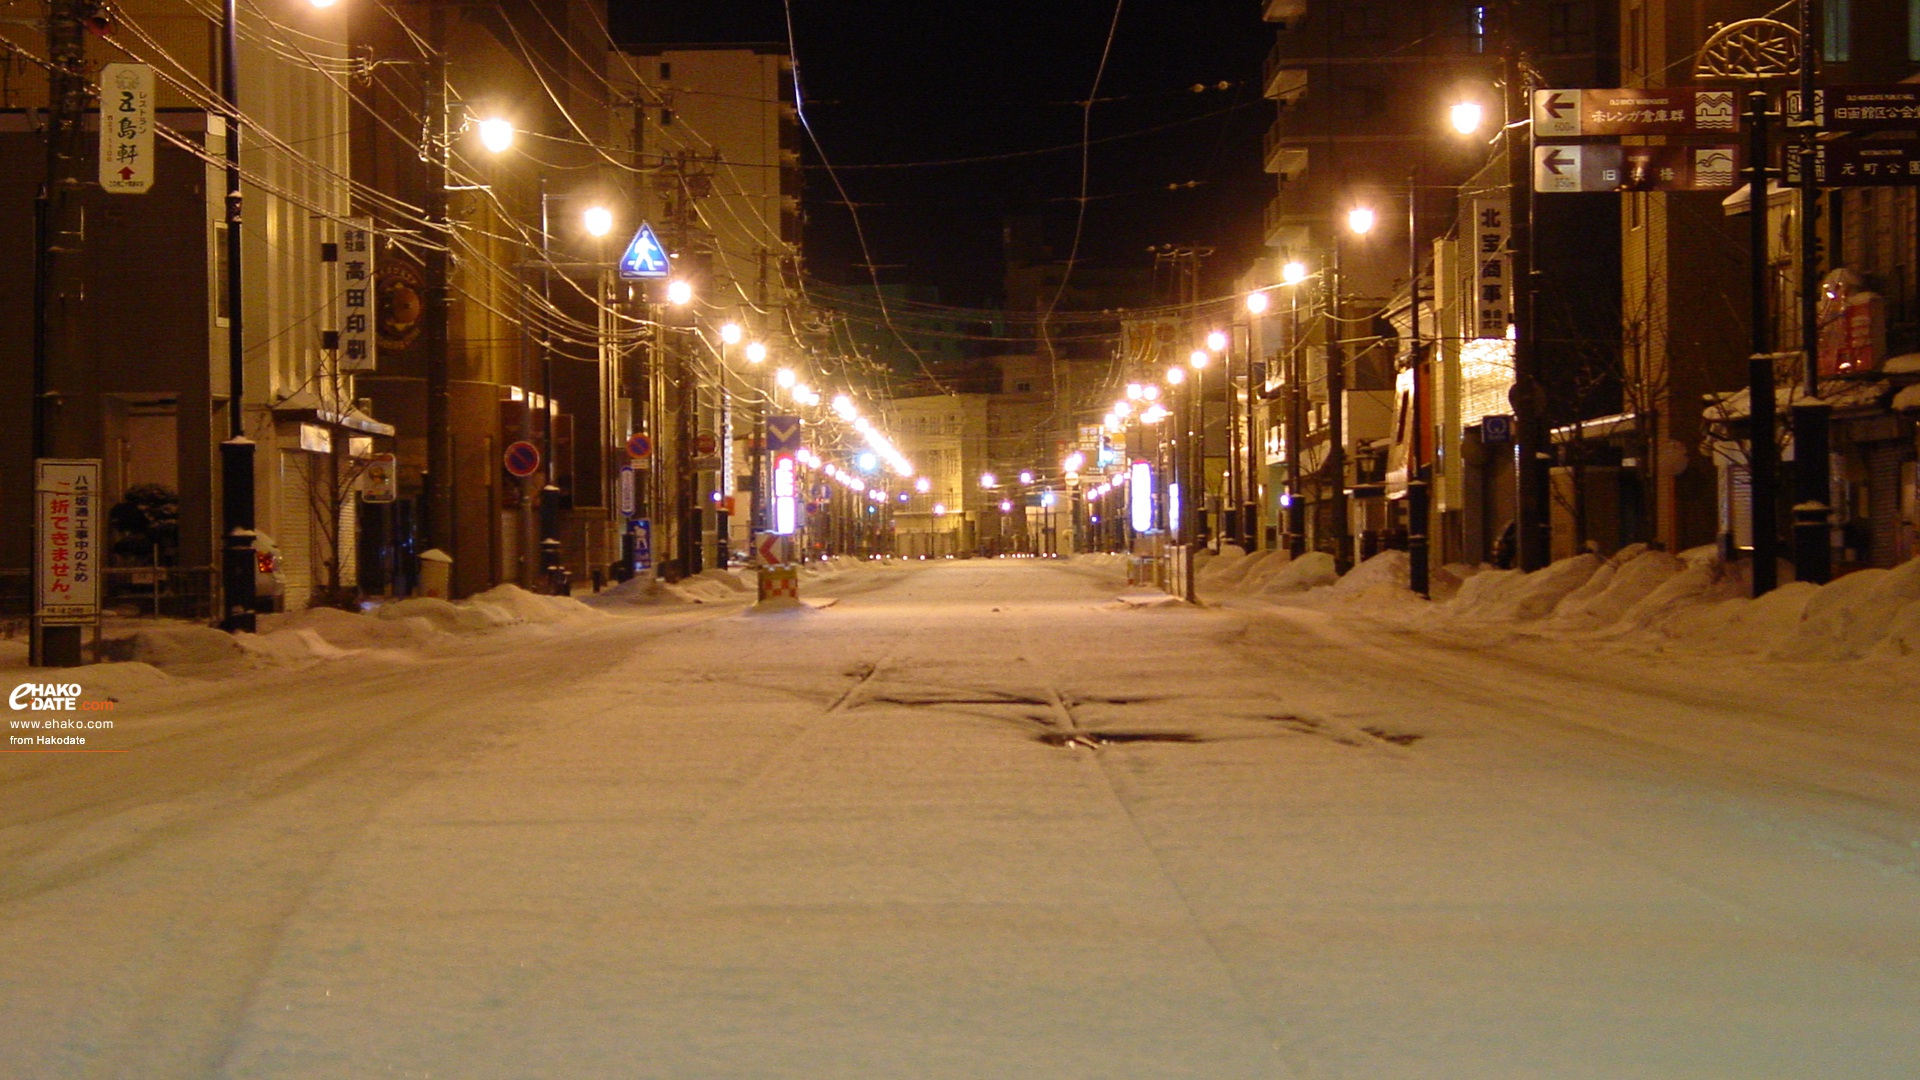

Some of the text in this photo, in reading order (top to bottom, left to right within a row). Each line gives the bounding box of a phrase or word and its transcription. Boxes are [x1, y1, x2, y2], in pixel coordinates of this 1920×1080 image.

[138, 91, 147, 134] レストラン
[1592, 109, 1685, 123] 赤レンガ倉庫群
[344, 260, 367, 360] 高田印刷
